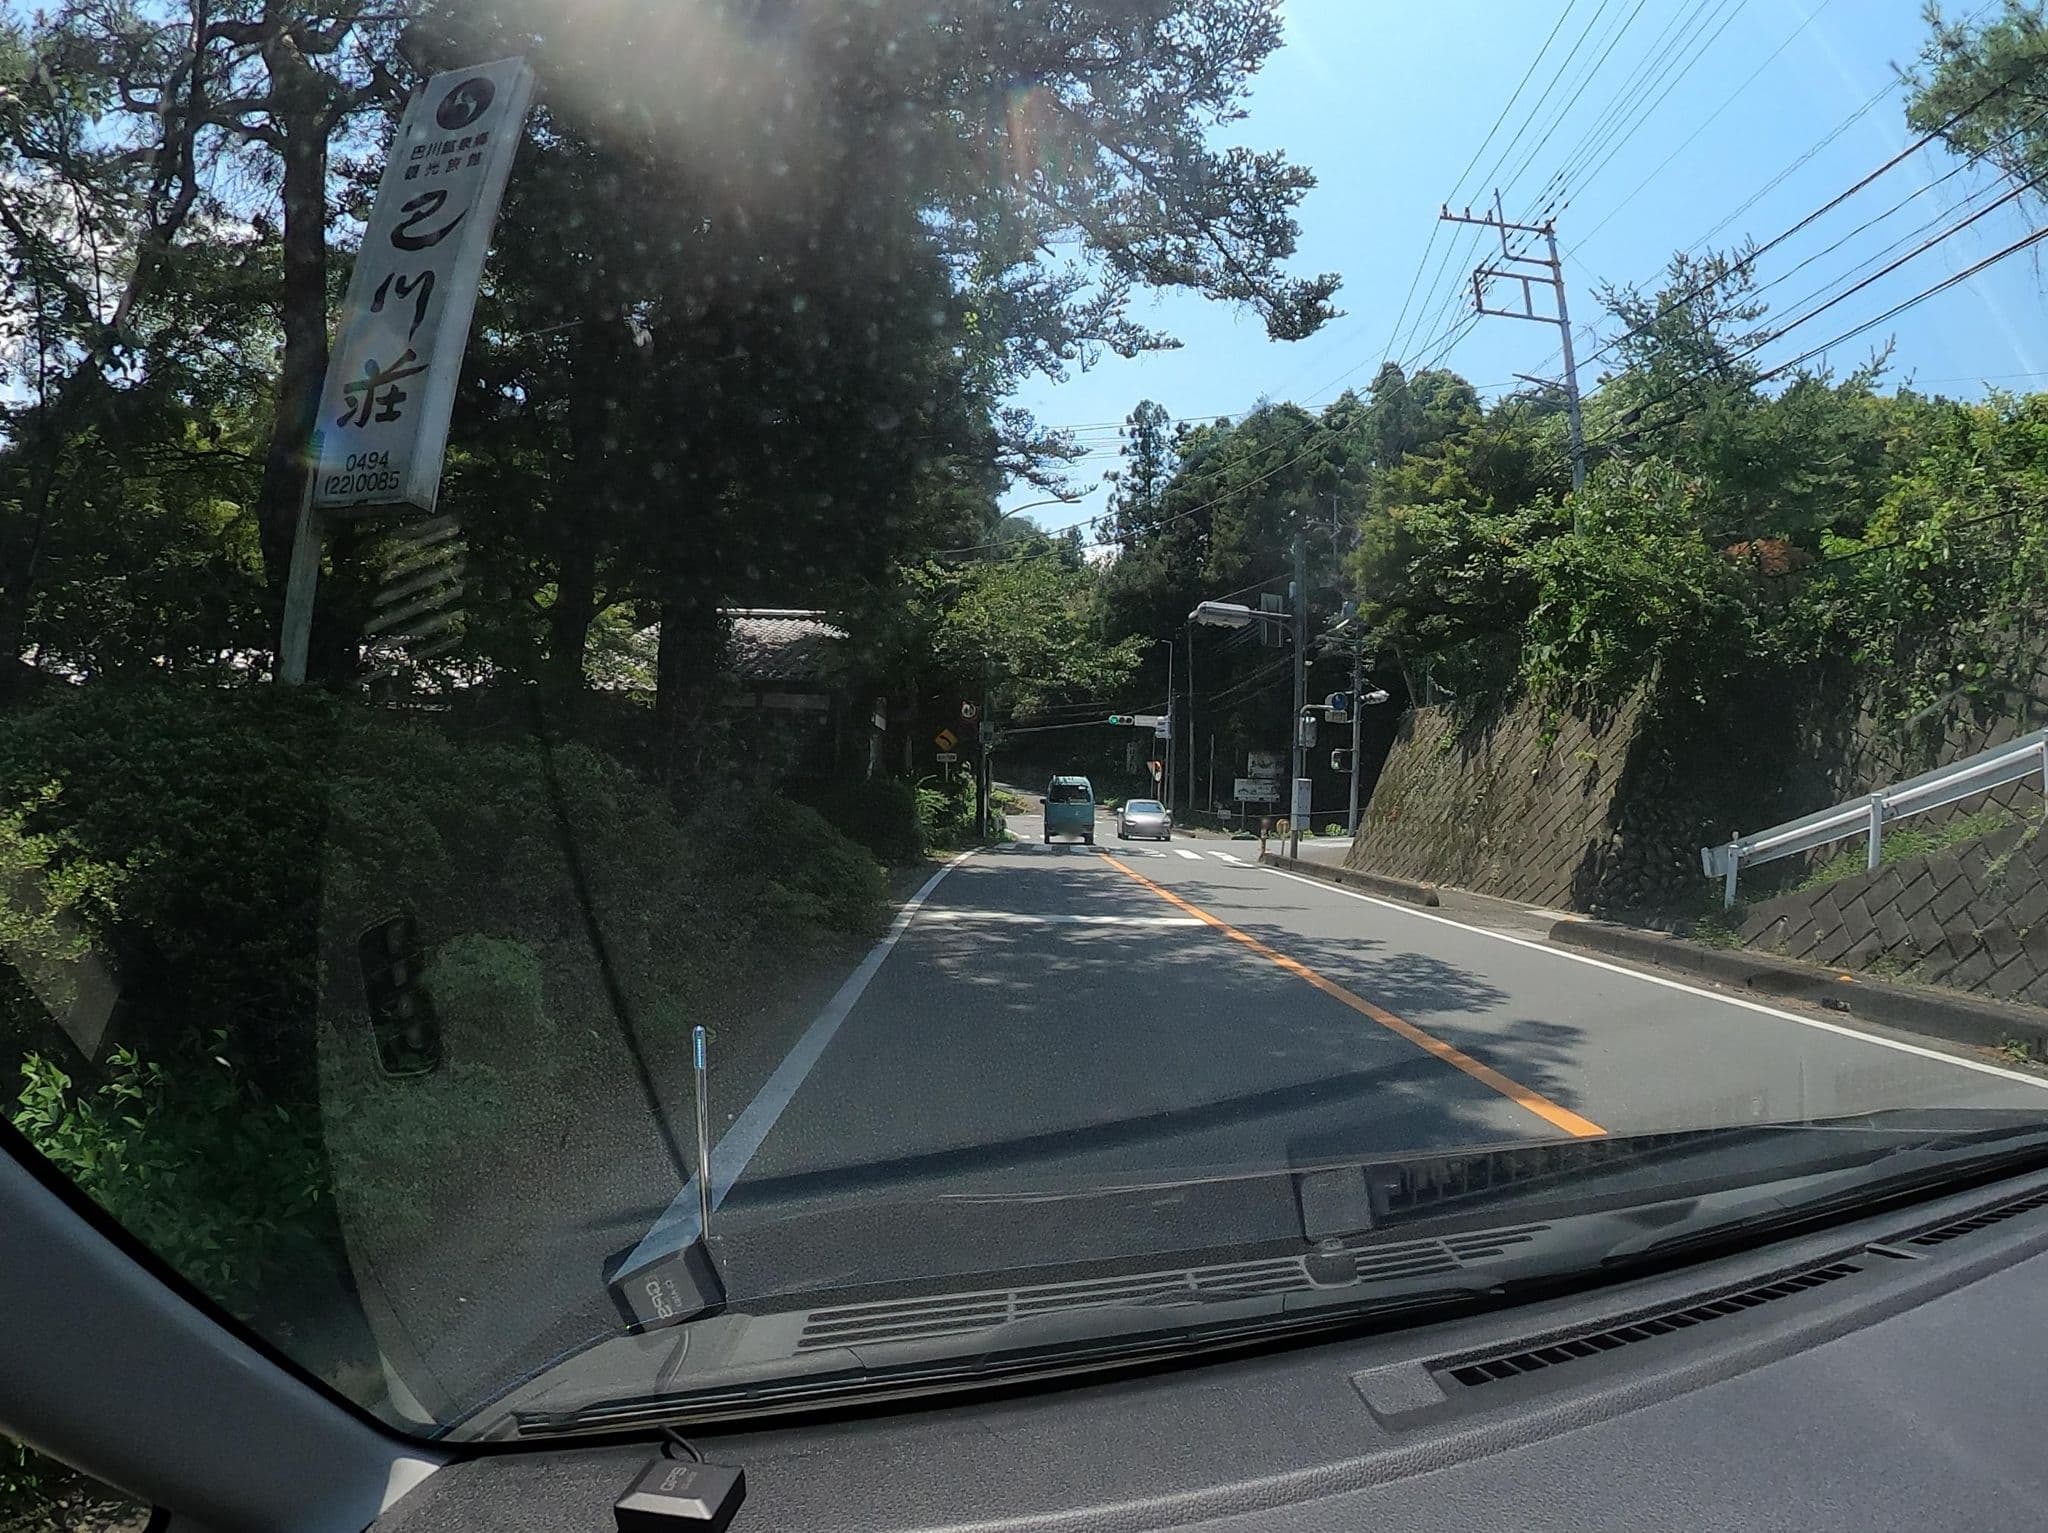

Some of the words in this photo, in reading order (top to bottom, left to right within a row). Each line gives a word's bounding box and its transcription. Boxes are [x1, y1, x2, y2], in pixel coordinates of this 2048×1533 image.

[345, 451, 389, 472] 0494
[324, 470, 401, 496] (22)0085
[660, 1467, 687, 1491] GPS
